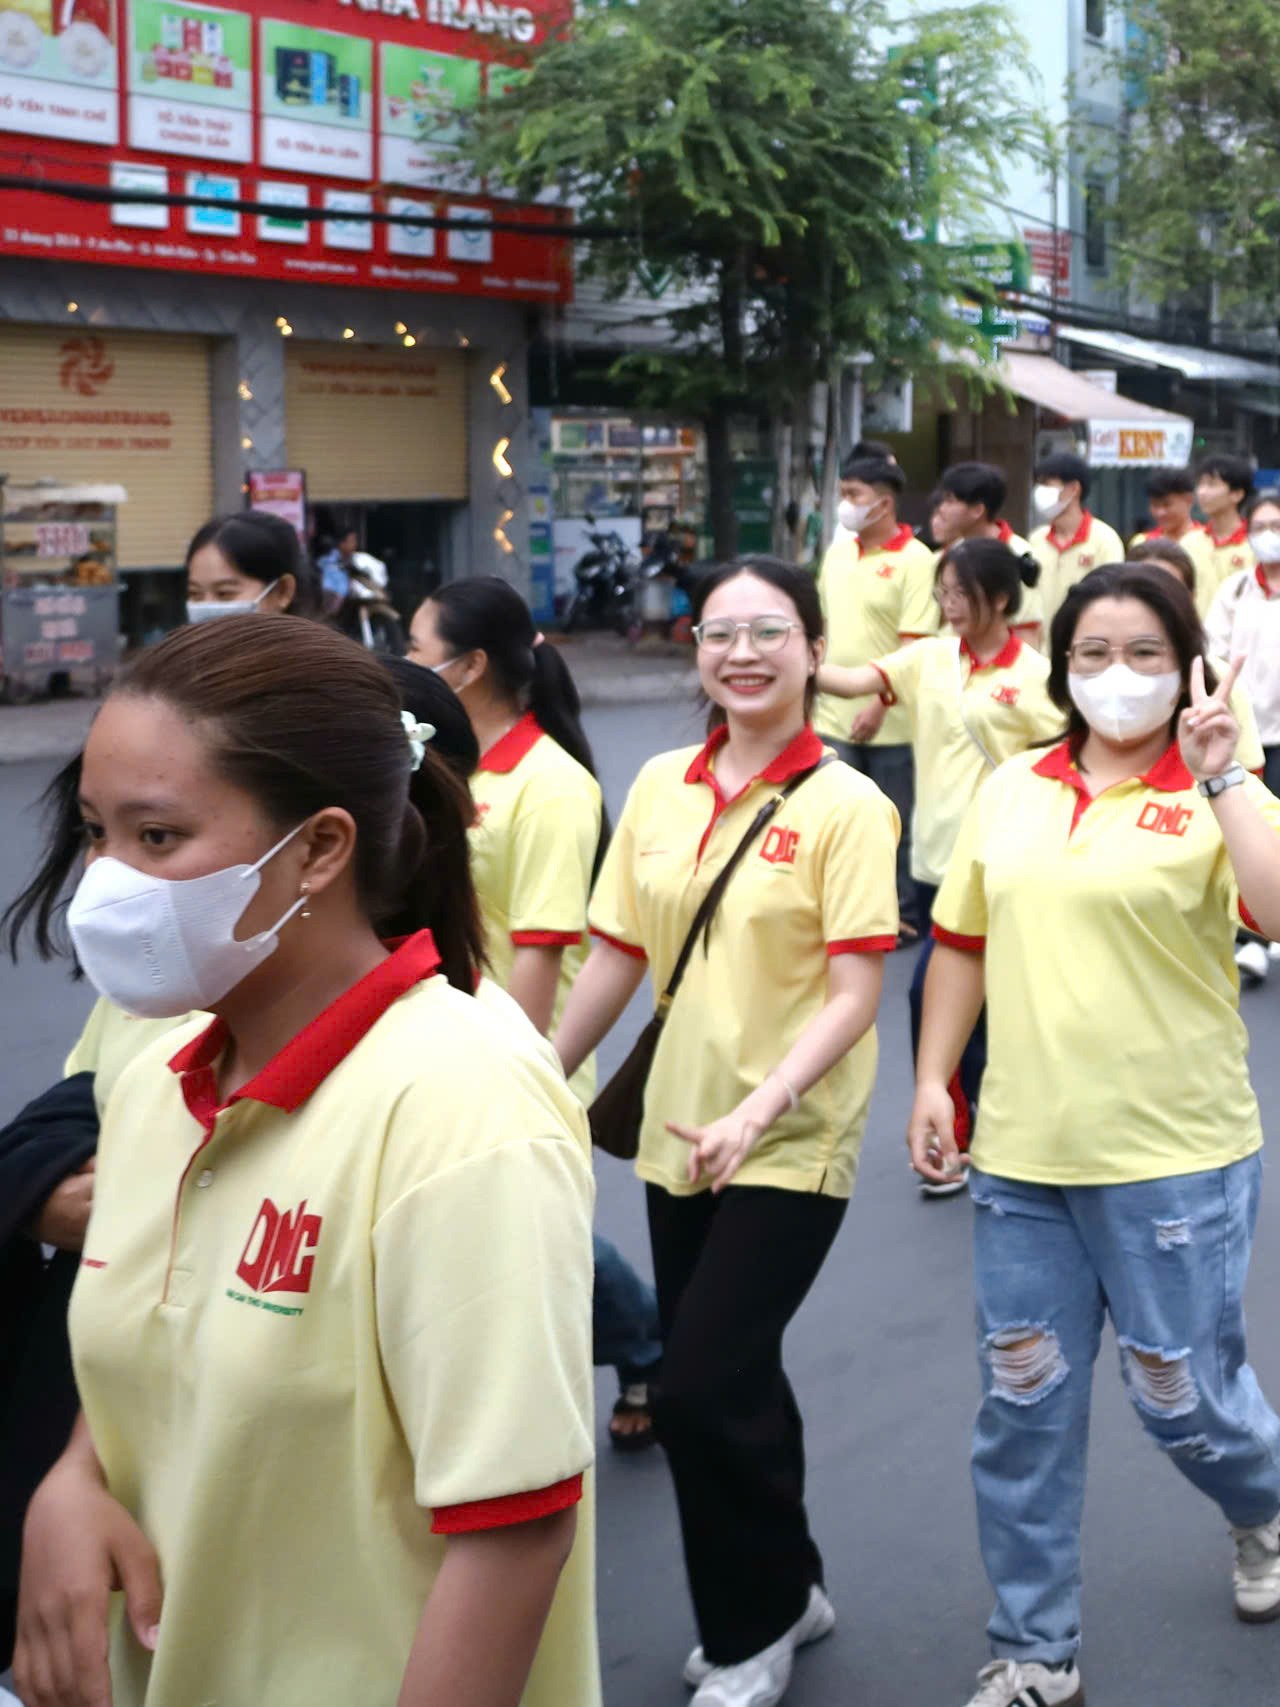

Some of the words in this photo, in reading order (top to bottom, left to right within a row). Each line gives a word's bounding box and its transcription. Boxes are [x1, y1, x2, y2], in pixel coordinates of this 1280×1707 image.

[1118, 428, 1166, 459] KENT
[1136, 801, 1194, 837] DNC
[236, 1198, 323, 1293] DNC
